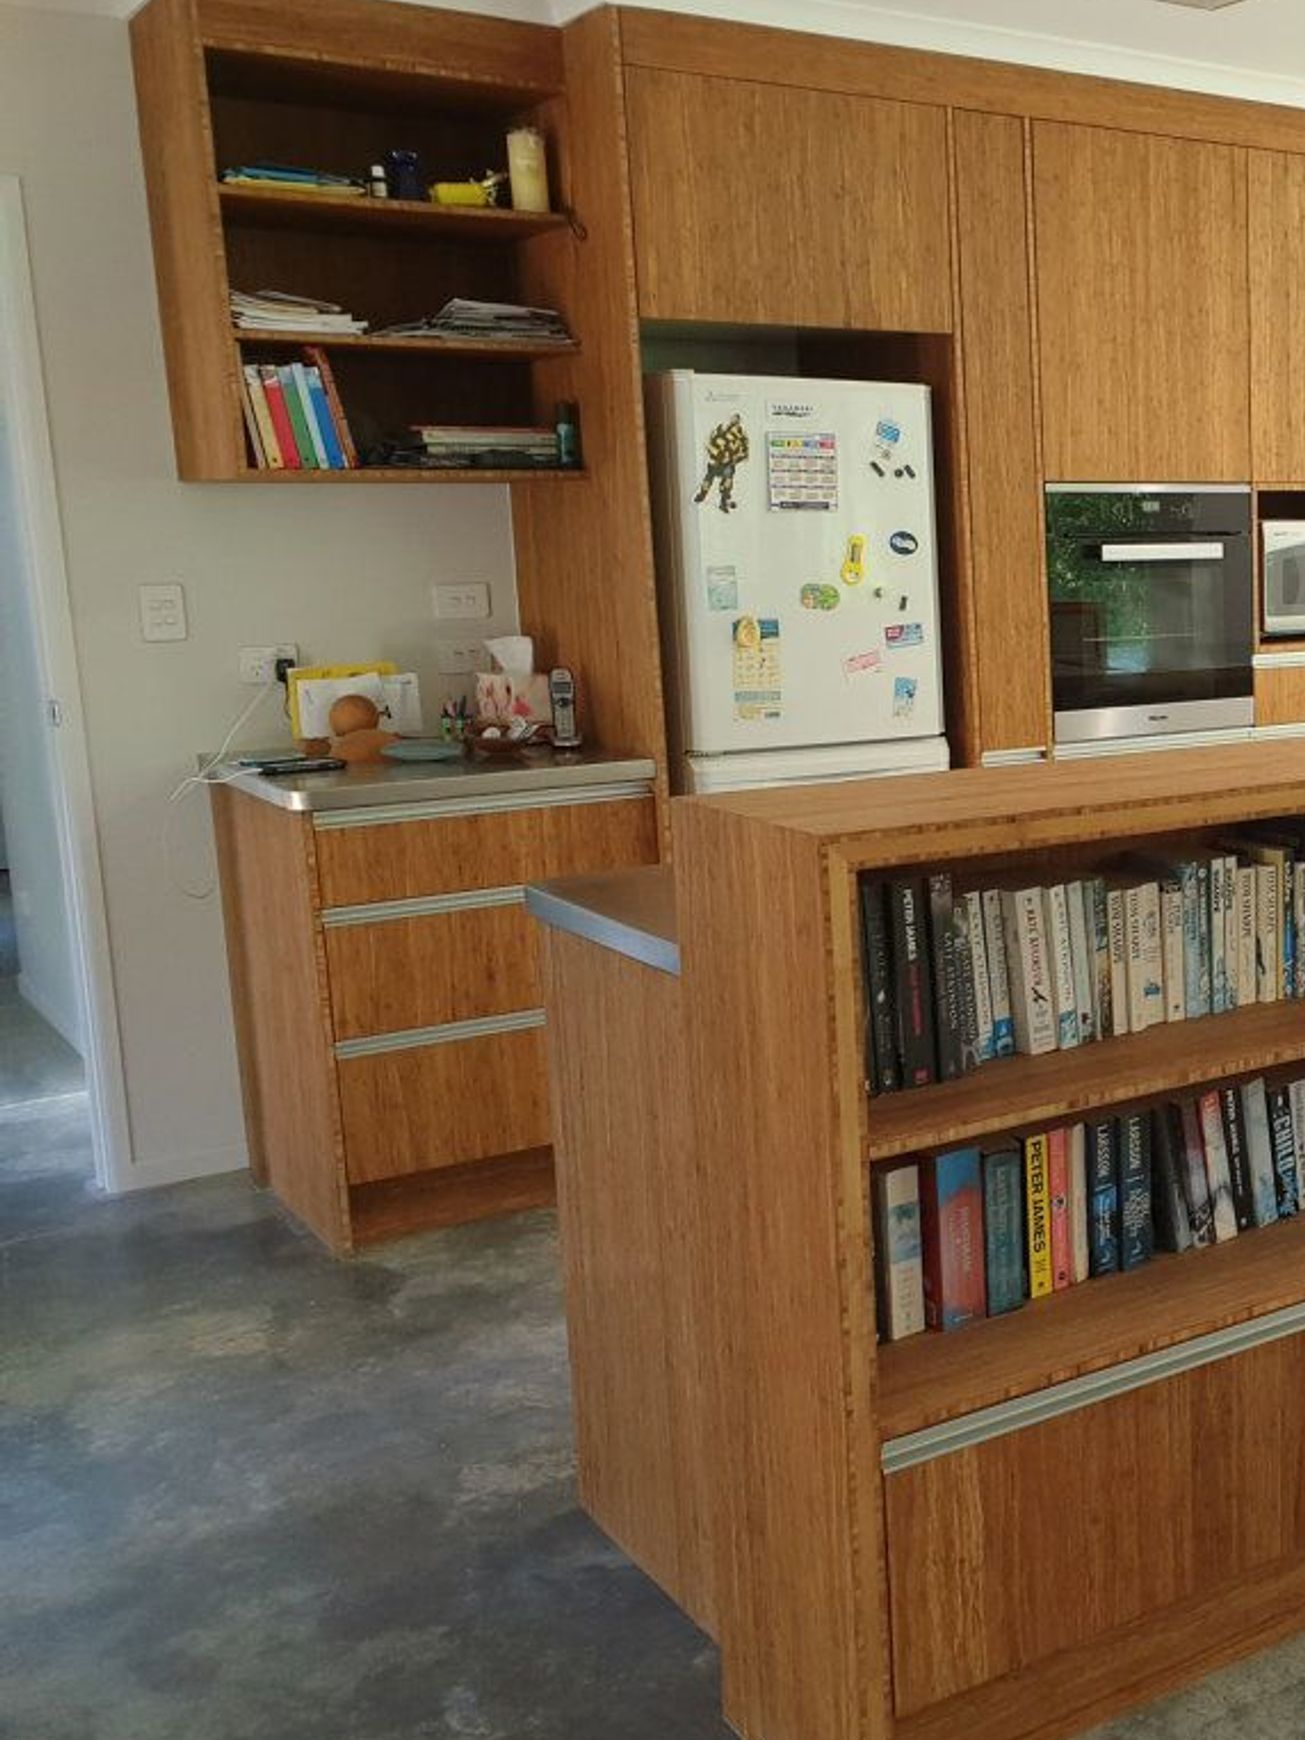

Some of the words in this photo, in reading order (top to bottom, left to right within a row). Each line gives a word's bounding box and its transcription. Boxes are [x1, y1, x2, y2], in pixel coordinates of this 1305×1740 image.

[902, 888, 917, 925] PETER
[1025, 908, 1038, 934] KATE
[905, 925, 918, 962] JAMES
[1273, 1114, 1296, 1172] CHILD
[1030, 1139, 1044, 1196] PETER
[1032, 1199, 1047, 1253] JAMES
